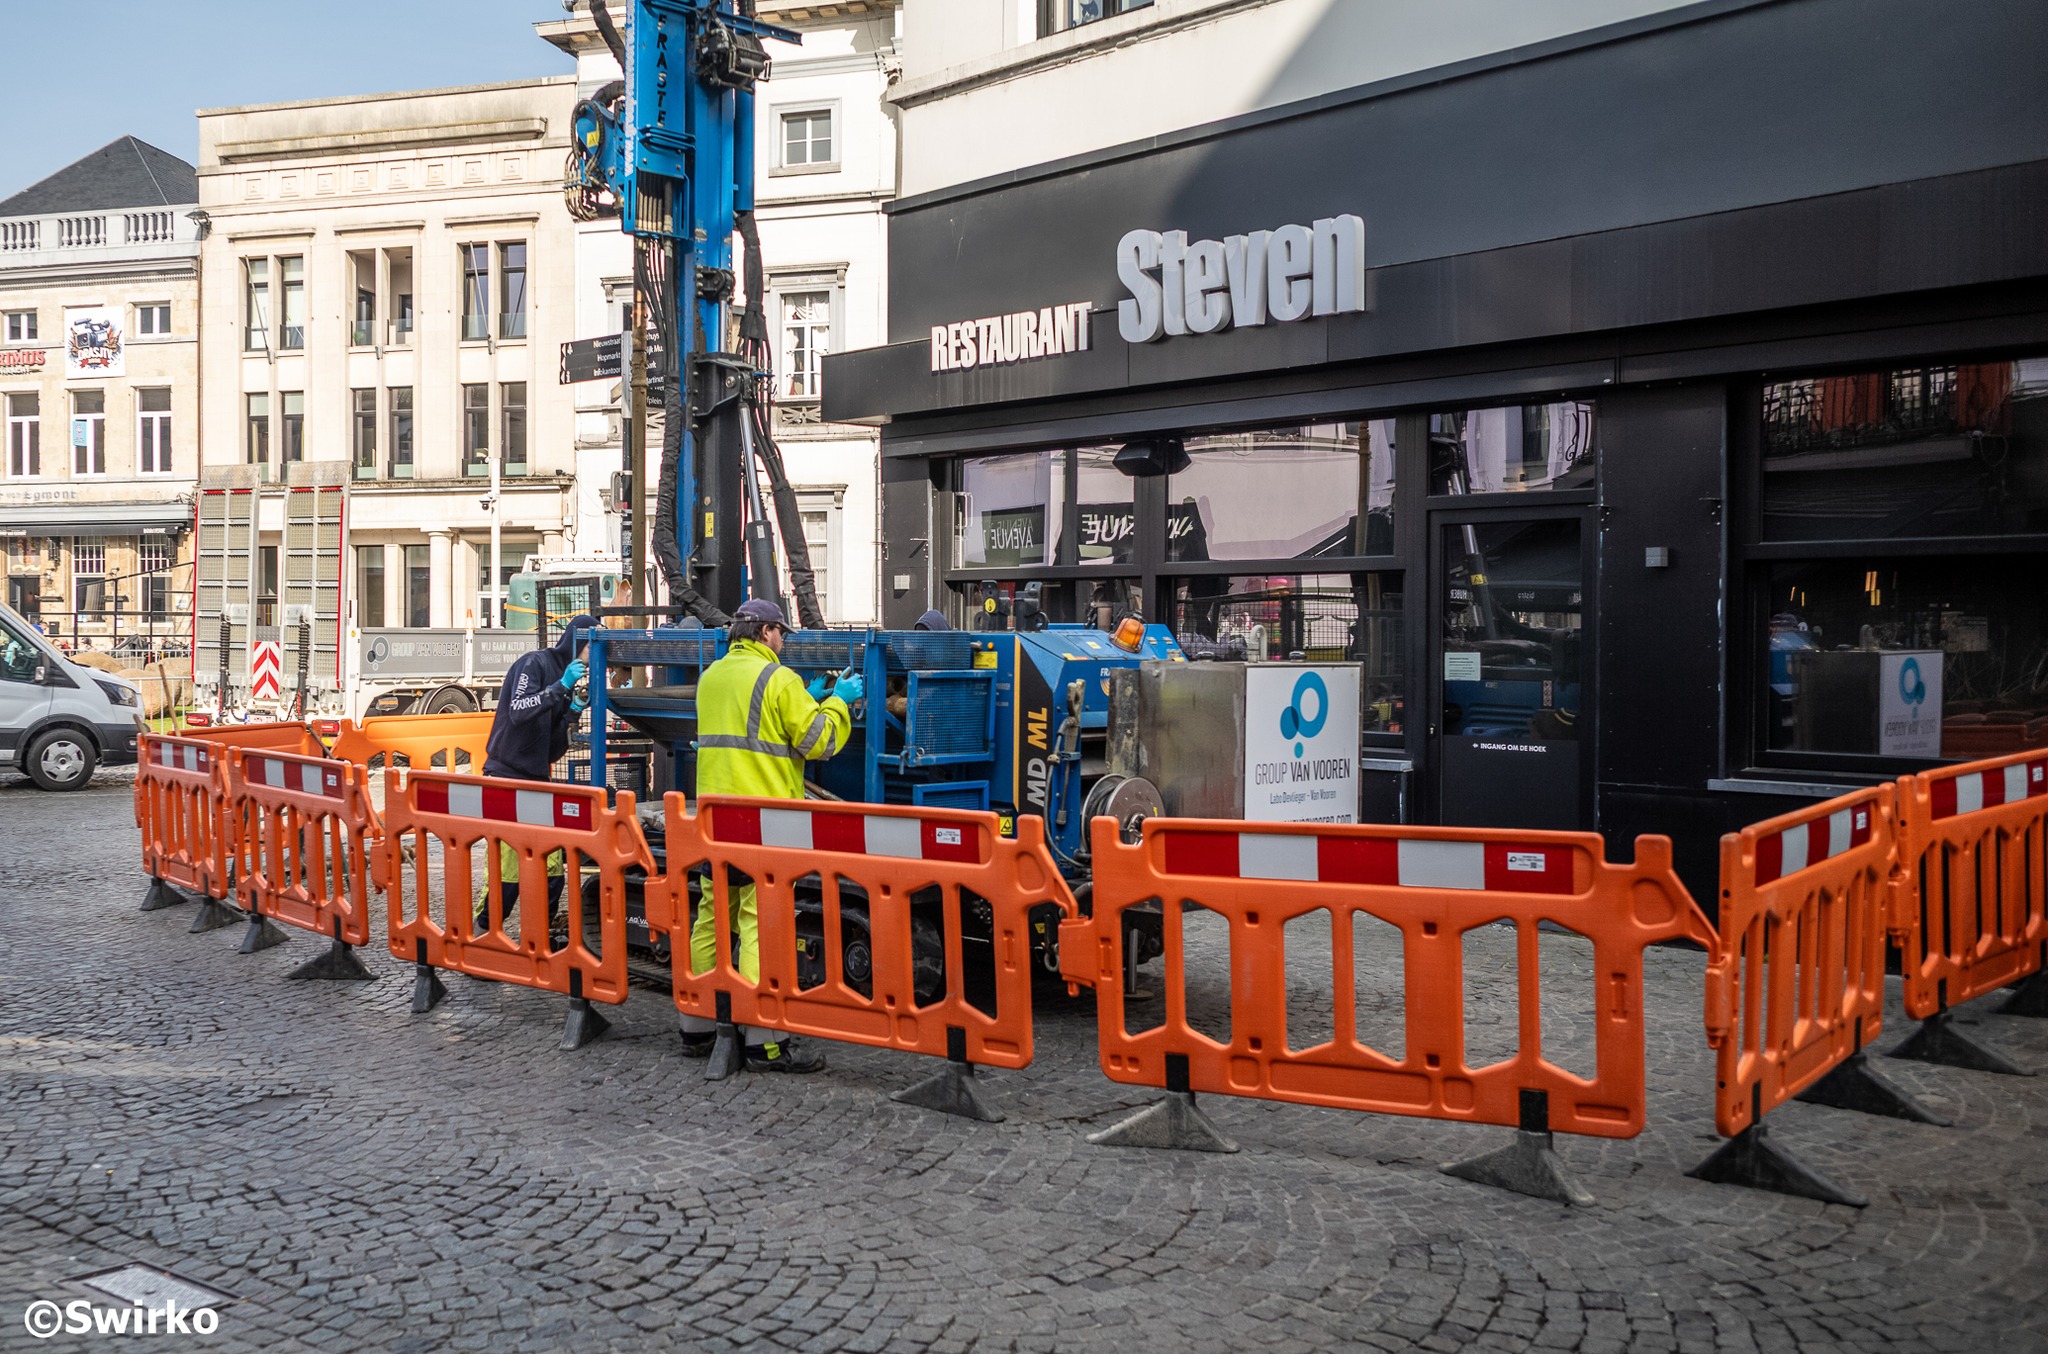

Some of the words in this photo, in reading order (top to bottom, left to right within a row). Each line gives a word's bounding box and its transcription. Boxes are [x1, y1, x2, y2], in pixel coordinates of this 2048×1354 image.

[656, 13, 669, 129] FRASTE
[1117, 213, 1365, 343] Steven
[931, 301, 1092, 372] RESTAURANT
[597, 351, 621, 363] Hopmarkt
[593, 366, 621, 378] Infokantoor
[391, 641, 416, 658] GROUP
[1028, 707, 1048, 750] ML
[1480, 742, 1506, 751] INGANG
[1529, 745, 1547, 753] HOEK
[1027, 758, 1047, 808] MD
[1255, 762, 1288, 785] GROUP
[1290, 760, 1310, 782] VAN
[1313, 758, 1351, 780] VOOREN
[1310, 789, 1319, 800] Van
[1320, 788, 1336, 800] Vooren
